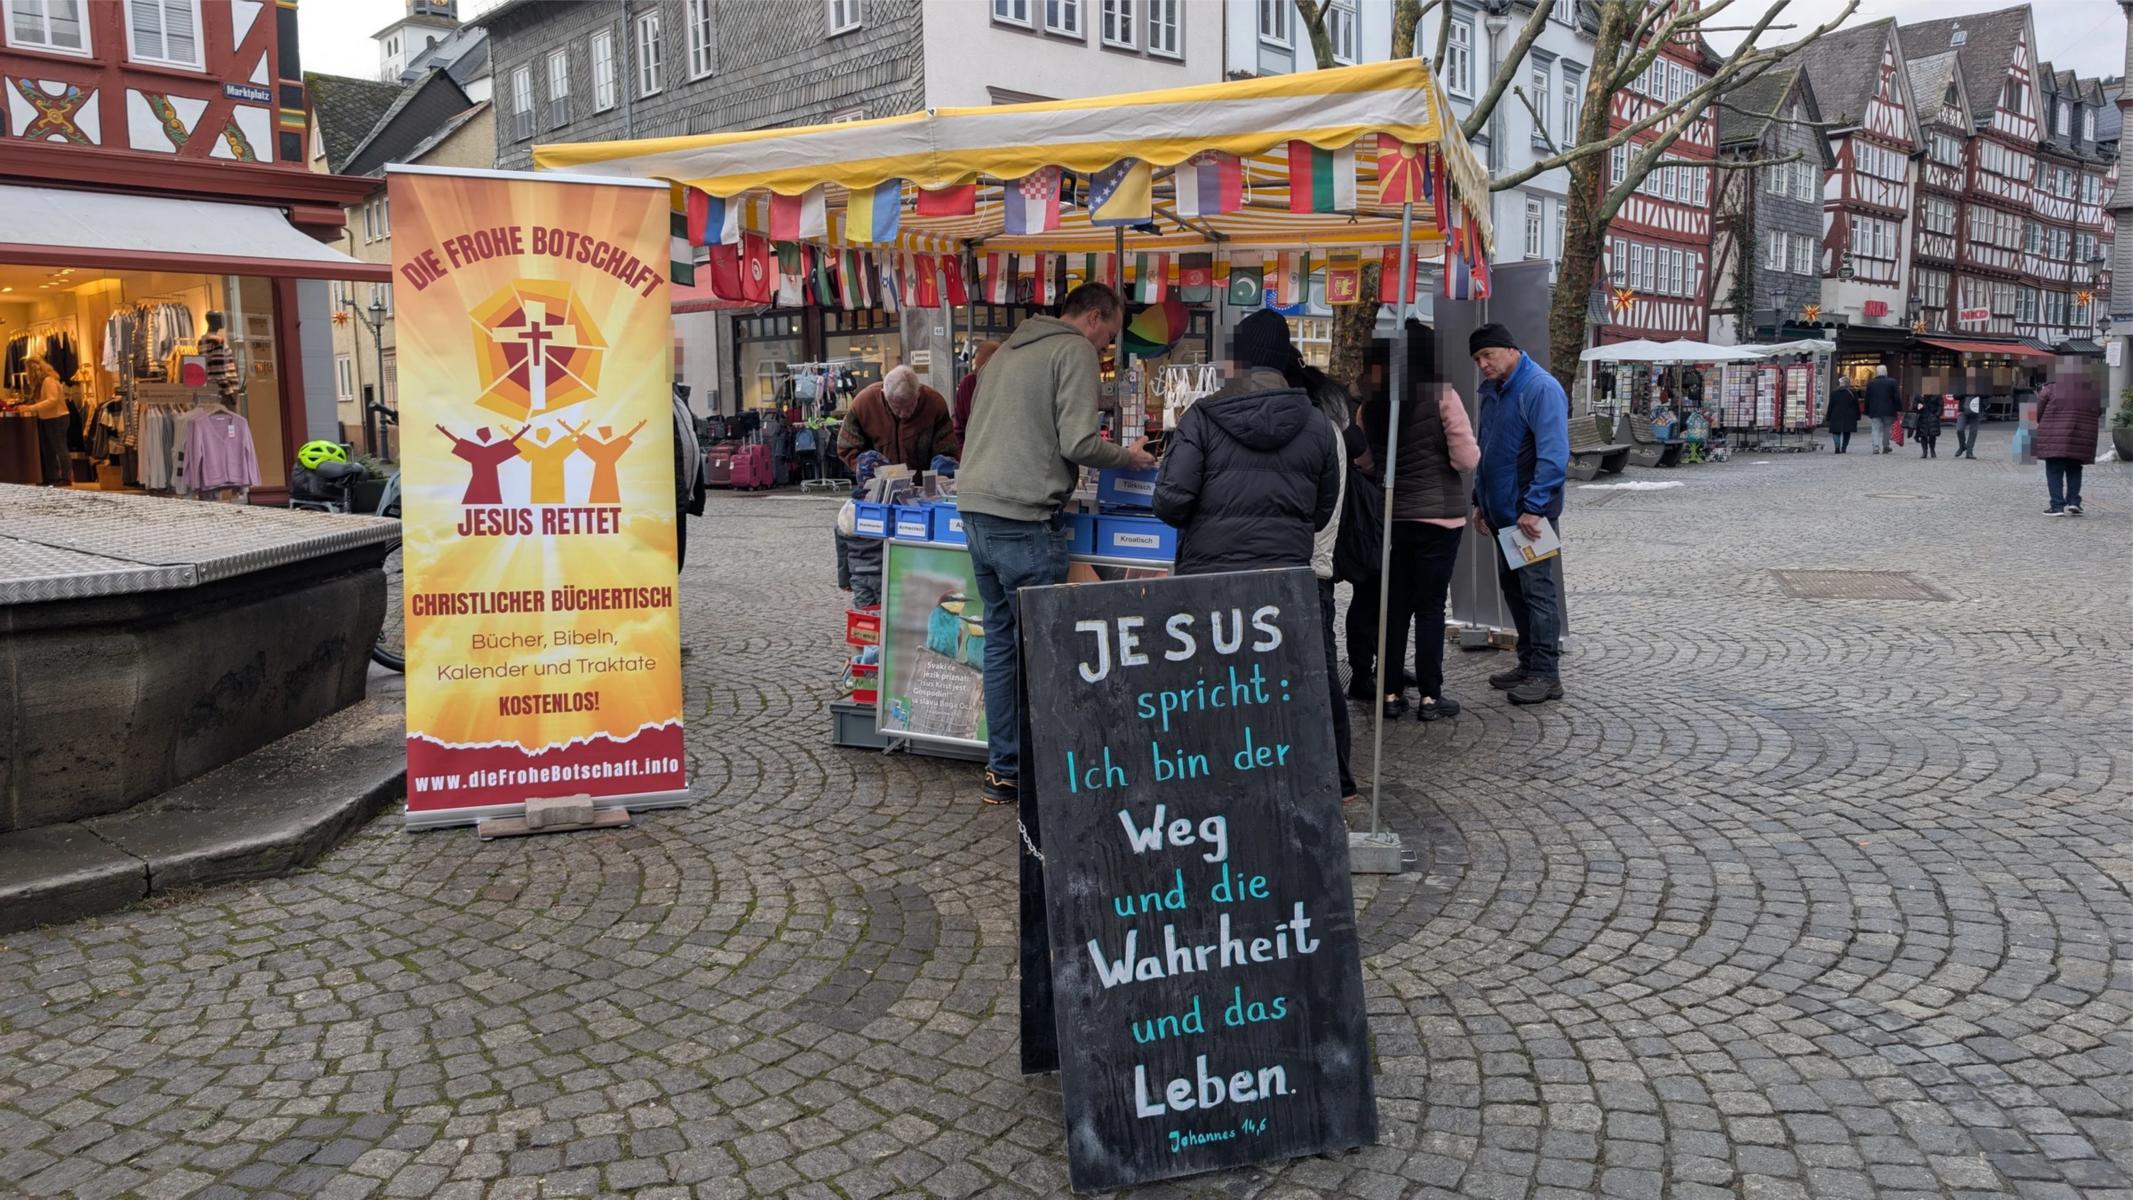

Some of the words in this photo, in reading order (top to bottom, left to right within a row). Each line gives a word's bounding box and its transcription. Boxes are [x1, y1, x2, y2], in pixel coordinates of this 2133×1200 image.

[226, 84, 270, 100] Marktplatz
[399, 248, 448, 291] DIE
[442, 226, 525, 270] FROHE
[532, 226, 665, 298] BOTSCHAFT
[1960, 308, 1989, 320] NKD
[457, 508, 533, 536] JESUS
[542, 507, 621, 535] RETTET
[1120, 535, 1153, 544] Kroatisch
[412, 590, 545, 616] CHRISTLICHER
[551, 585, 672, 612] BÜCHERTISCH
[472, 632, 548, 650] Bücher,
[554, 629, 618, 646] Bibeln,
[1075, 605, 1283, 683] JESUS
[437, 662, 529, 681] Kalender
[533, 656, 571, 675] und
[576, 656, 656, 673] Traktate
[499, 691, 600, 716] KOSTENLOS!
[415, 757, 679, 792] www.dieFroheBotschaft.info
[1067, 746, 1128, 793] Ich
[1153, 742, 1210, 782] bin
[1234, 726, 1290, 770] der
[1118, 803, 1228, 863] Weg
[1114, 868, 1187, 917] und
[1210, 862, 1270, 902] die
[1087, 901, 1320, 989] Wahrheit
[1132, 994, 1205, 1044] und
[1224, 986, 1287, 1027] das
[1134, 1055, 1297, 1119] Leben.
[1168, 1127, 1236, 1153] Johannes
[1241, 1118, 1267, 1137] 14,6
